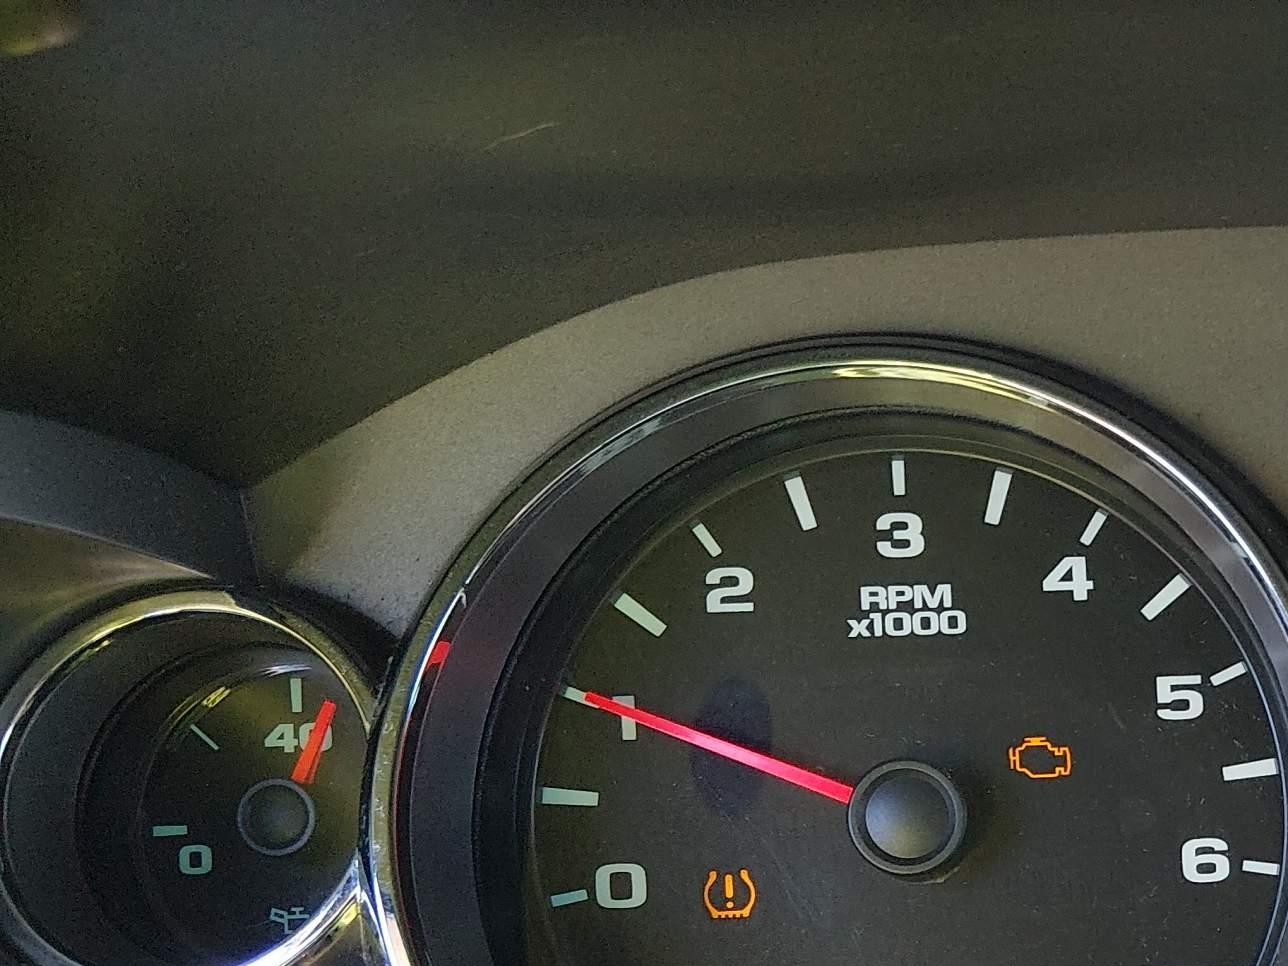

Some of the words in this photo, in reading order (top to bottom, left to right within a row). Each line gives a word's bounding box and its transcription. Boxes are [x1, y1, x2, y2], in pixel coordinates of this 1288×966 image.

[876, 512, 925, 557] 3
[705, 566, 755, 613] 2
[859, 584, 953, 611] RPM
[1042, 556, 1094, 601] 4
[847, 610, 967, 638] x1000
[1155, 675, 1203, 721] 5
[264, 722, 333, 753] 40
[178, 844, 213, 875] 0
[1181, 837, 1230, 883] 6
[596, 863, 647, 910] 0
